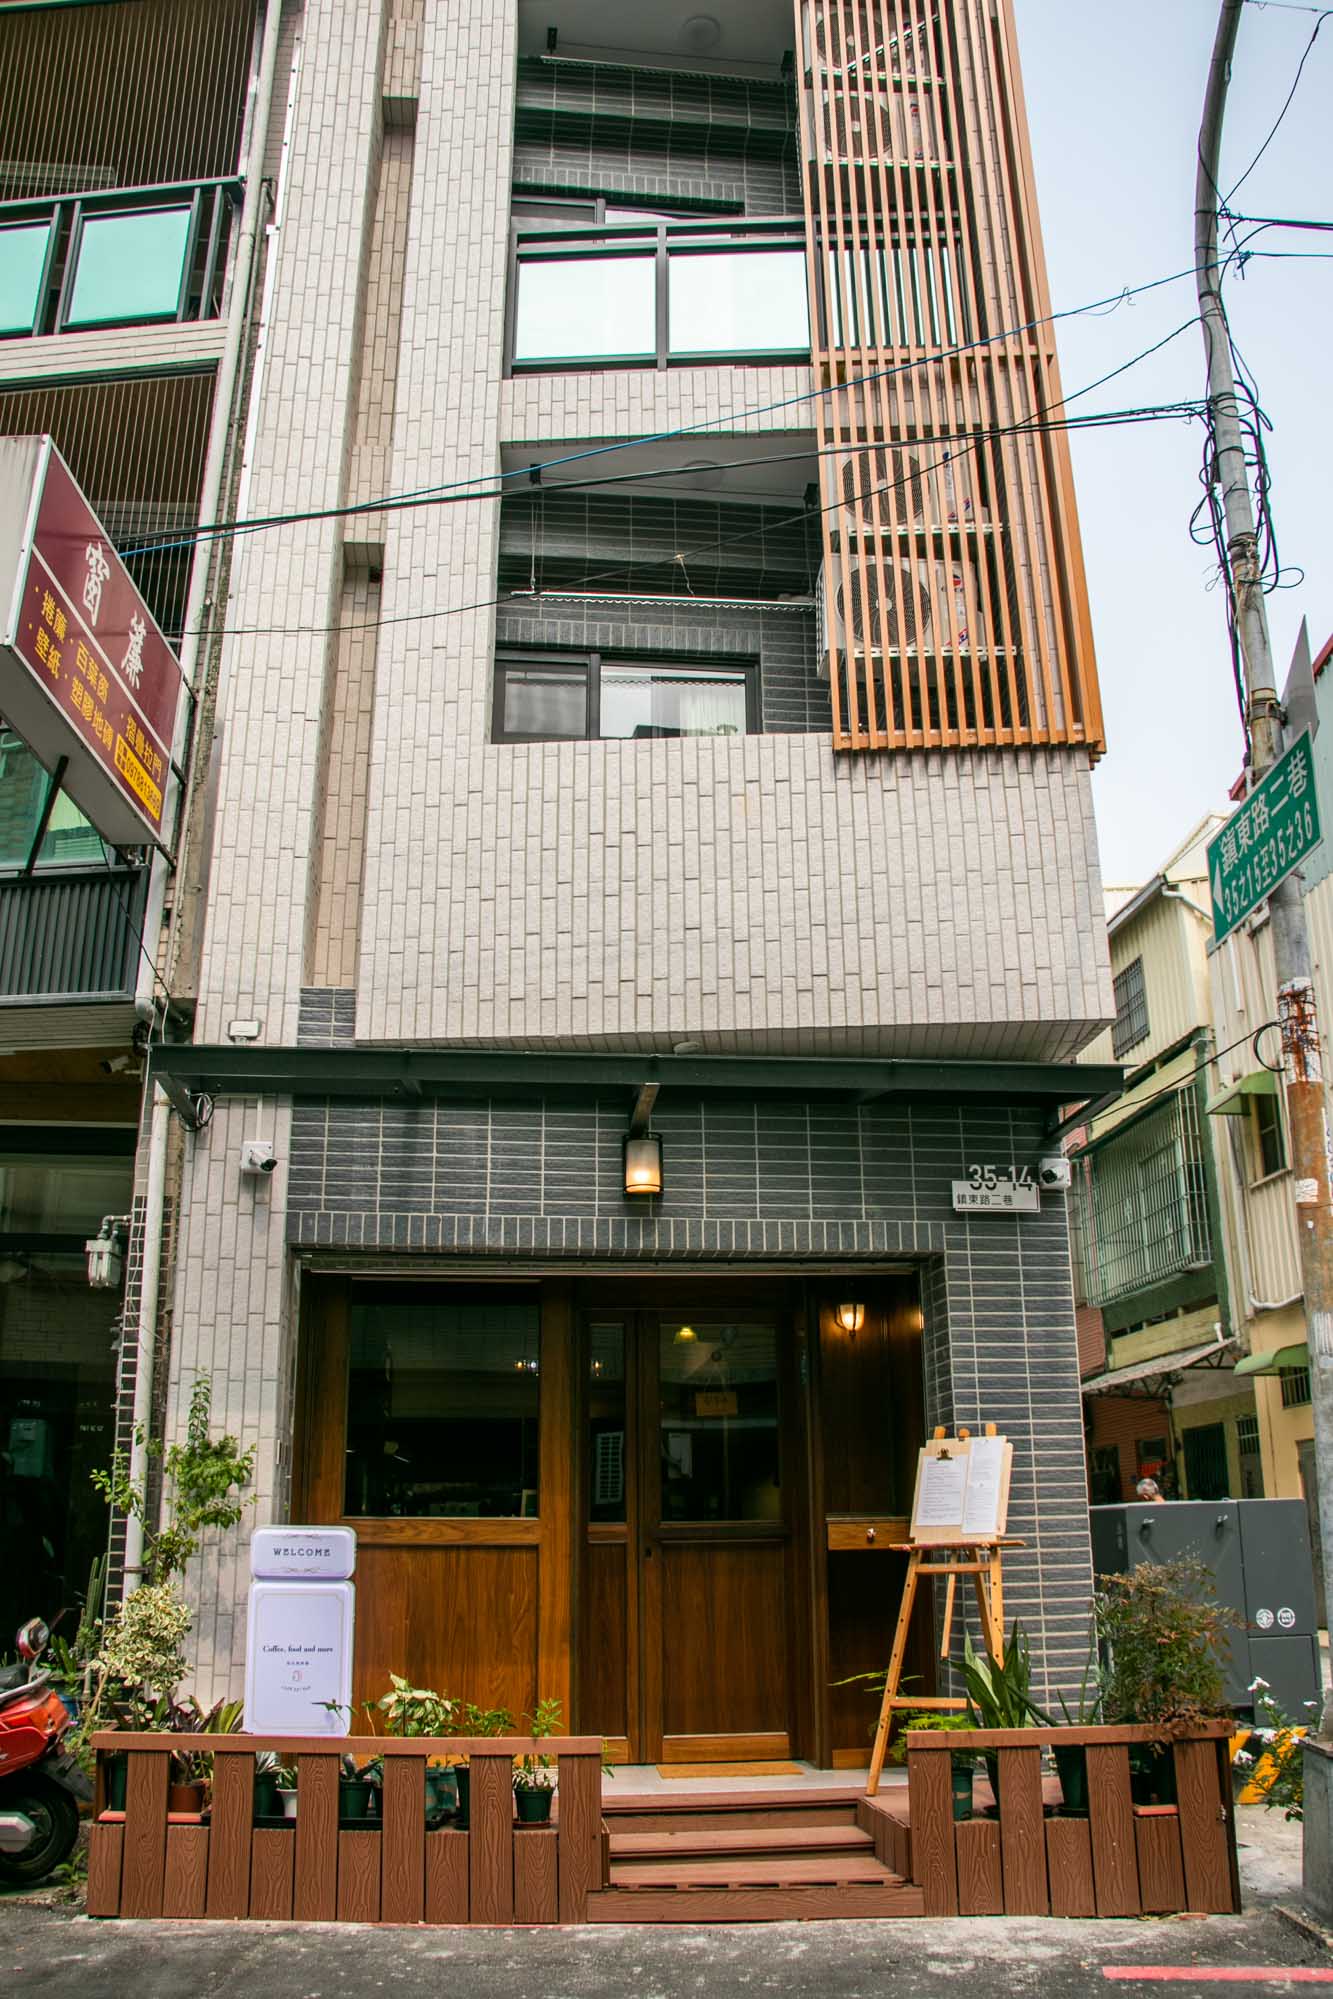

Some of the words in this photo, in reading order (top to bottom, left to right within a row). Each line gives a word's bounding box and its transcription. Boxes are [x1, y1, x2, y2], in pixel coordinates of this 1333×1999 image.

[35, 626, 62, 679] 壁紙
[1219, 750, 1309, 877] 鎮東路二巷
[968, 1164, 1033, 1191] 35-14
[273, 1547, 332, 1557] WELCOME
